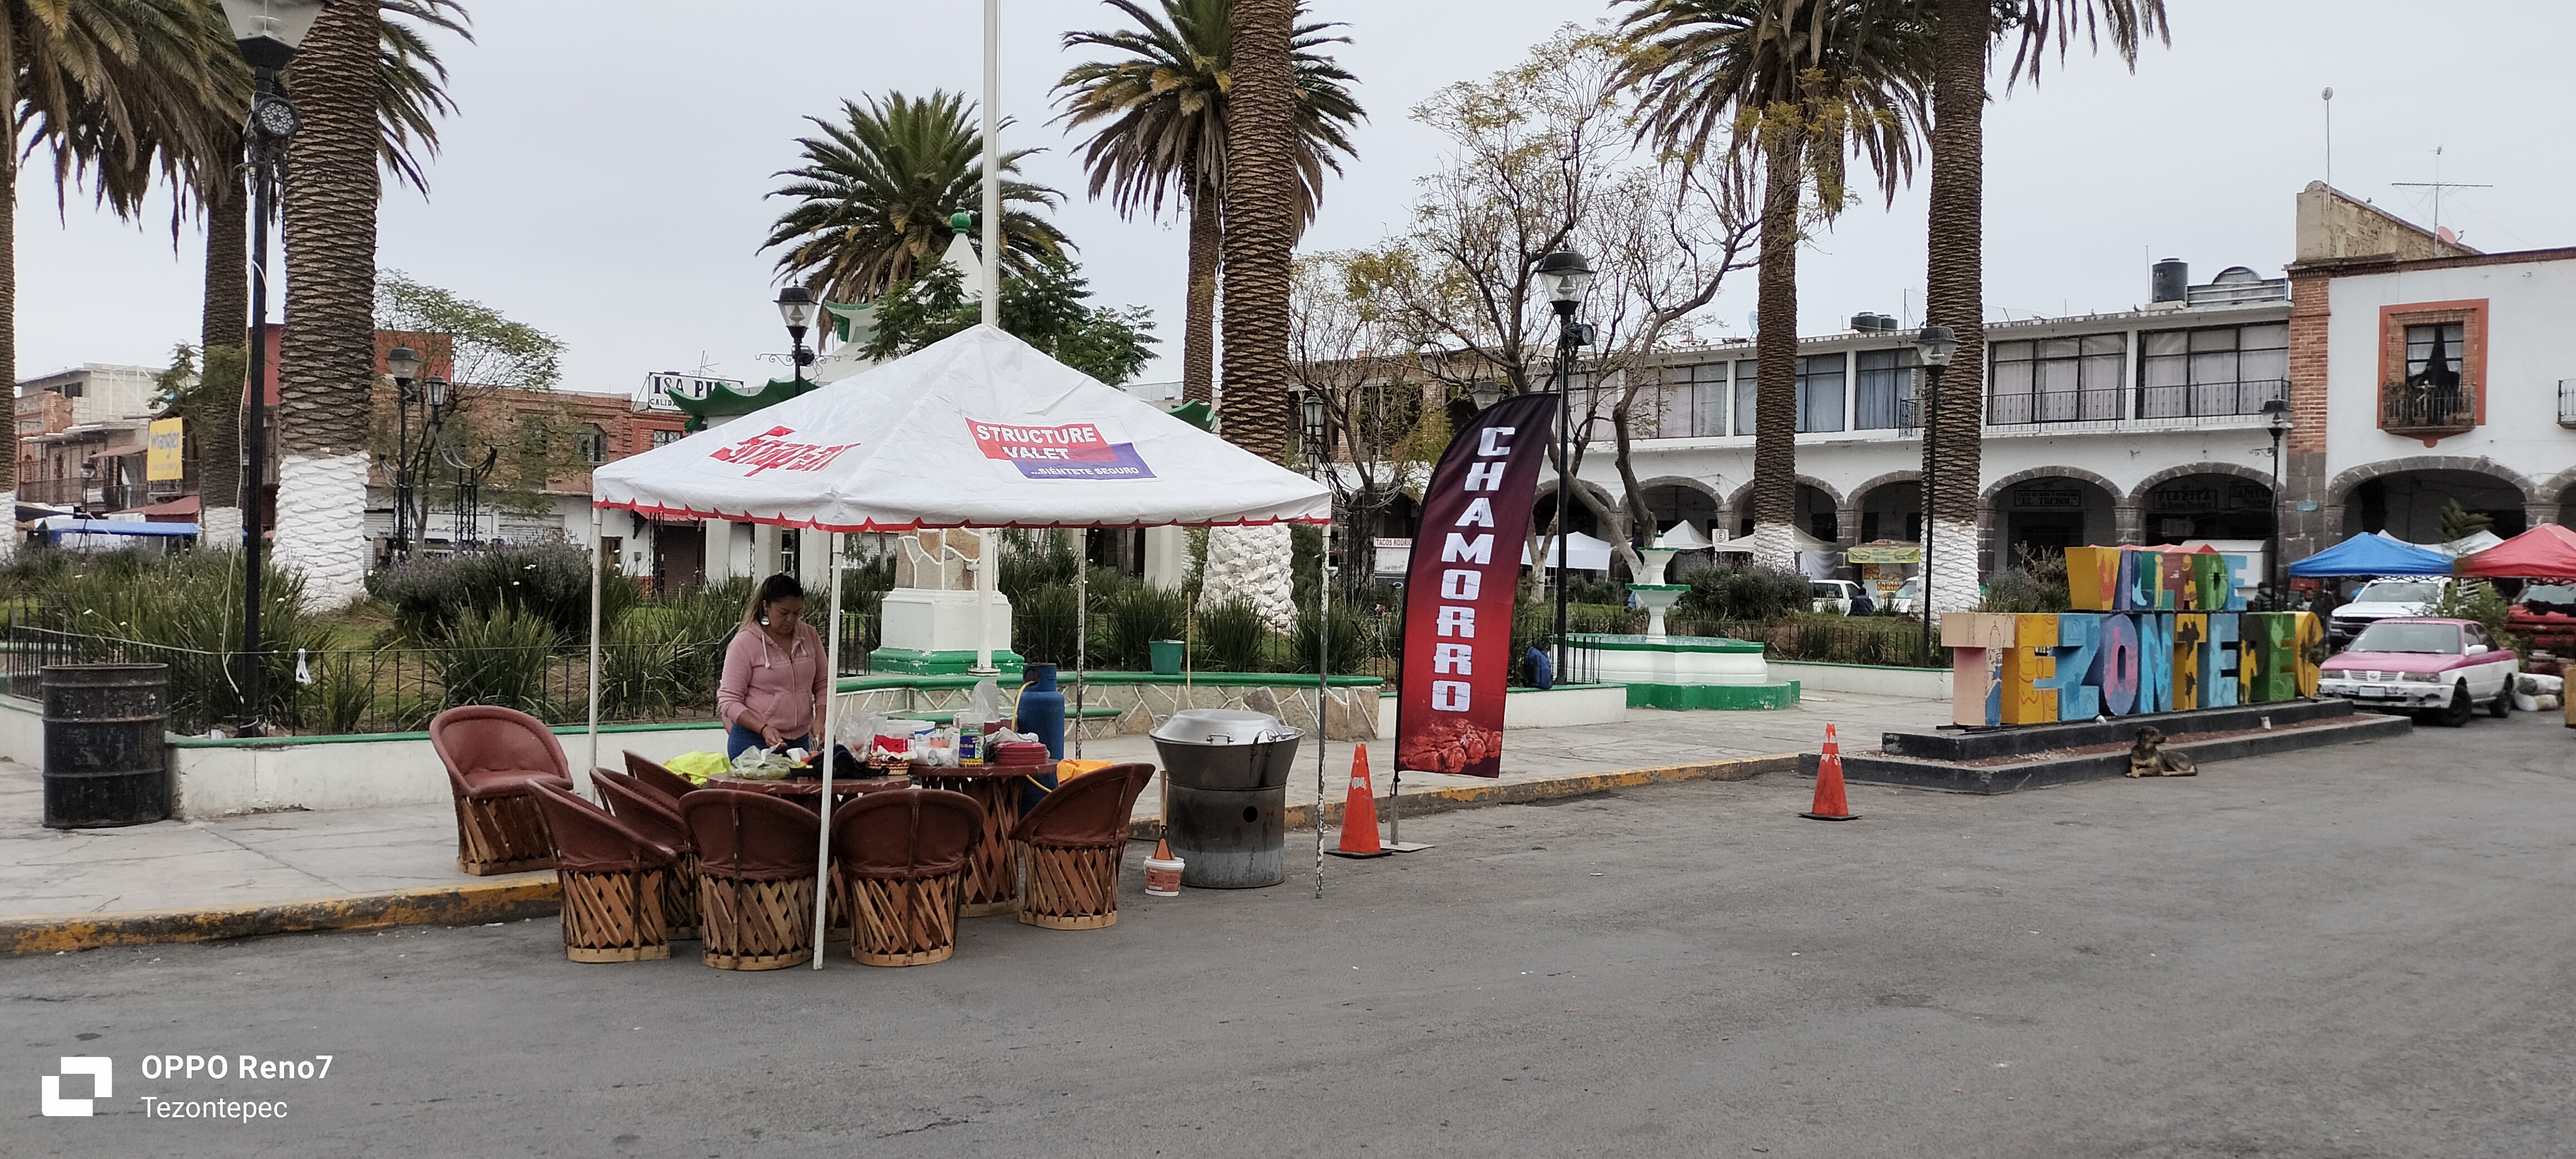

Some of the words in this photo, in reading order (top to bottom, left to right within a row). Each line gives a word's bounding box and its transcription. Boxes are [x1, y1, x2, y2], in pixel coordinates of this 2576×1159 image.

[653, 376, 684, 395] ISA
[976, 425, 1097, 444] STRUCTURE
[1002, 446, 1070, 460] VALET
[1432, 427, 1516, 712] CHAMORRO
[2192, 553, 2247, 611] DE
[1941, 611, 2323, 726] TEZONTEPEC
